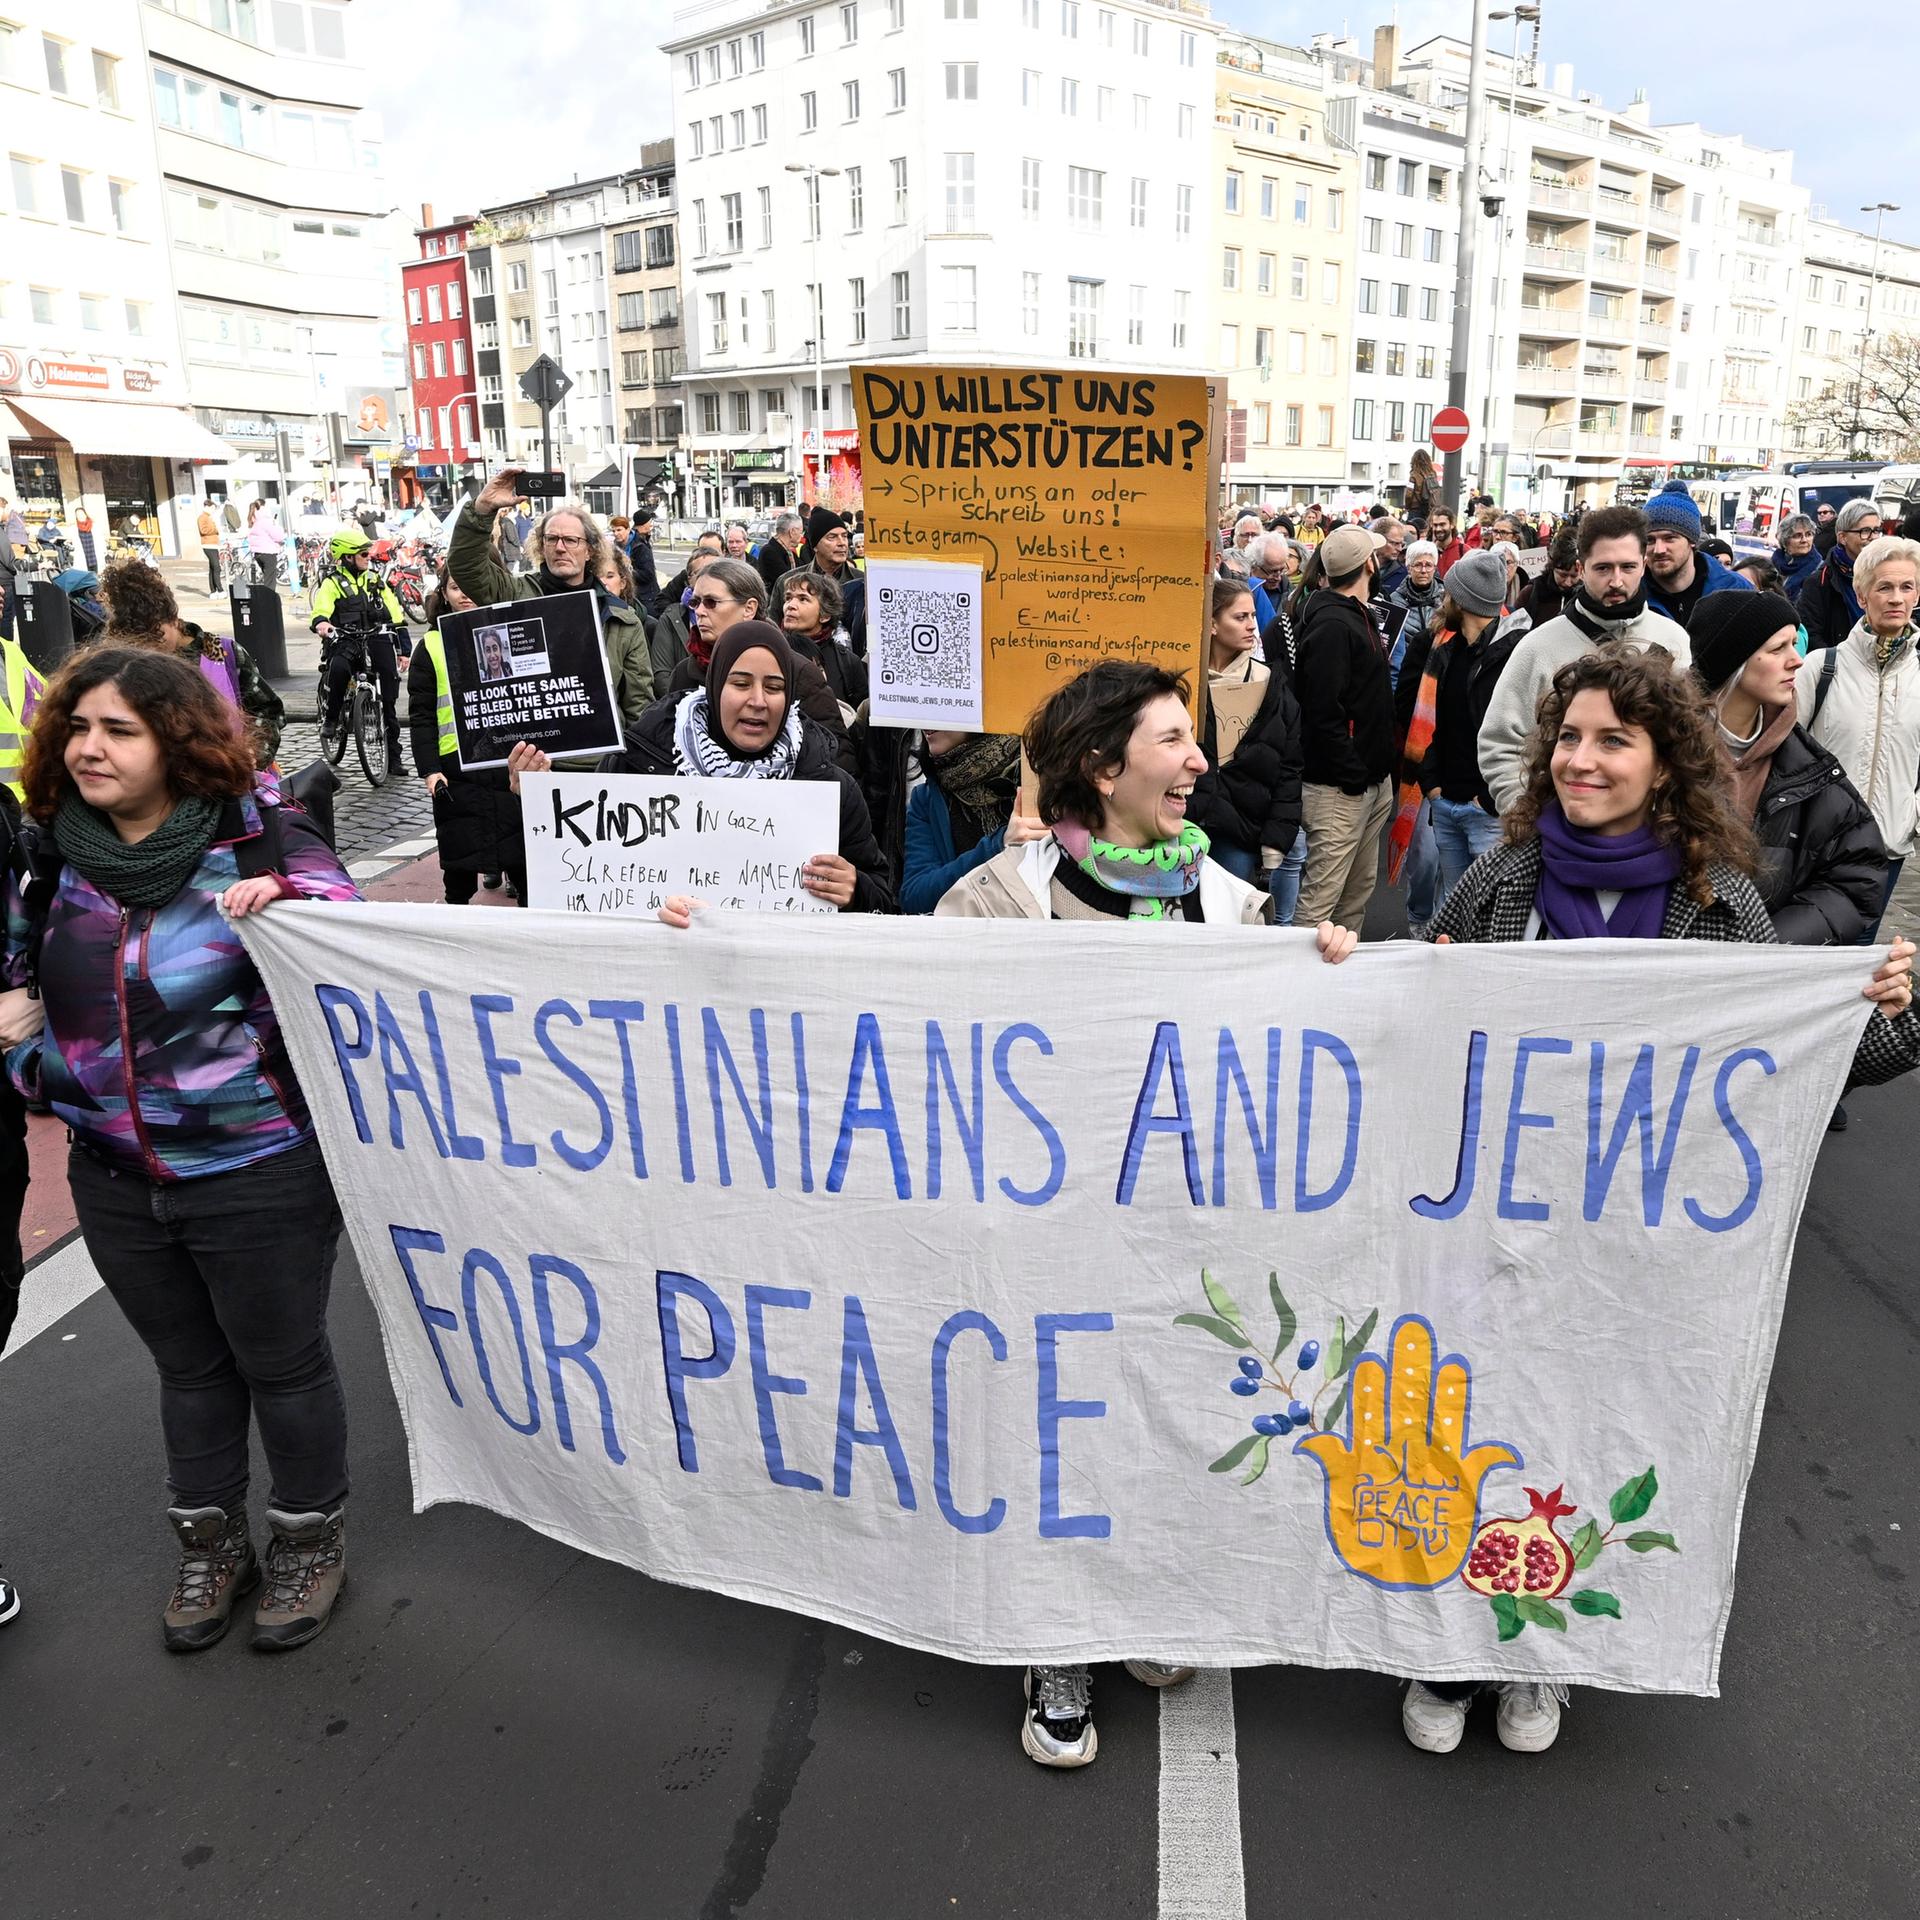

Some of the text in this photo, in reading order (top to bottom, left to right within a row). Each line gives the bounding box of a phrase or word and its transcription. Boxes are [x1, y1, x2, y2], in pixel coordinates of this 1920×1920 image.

[863, 373, 1155, 420] DU WILLST UNS
[869, 418, 1204, 471] UNTERSTÜTZEN?
[900, 475, 1148, 507] Sprich uns an oder
[1063, 504, 1120, 527] uns!
[868, 518, 978, 550] Instagram
[1047, 587, 1146, 604] wordpress.com
[990, 632, 1191, 659] palestiniansandjewsforpeace
[463, 676, 584, 704] WE LOOK THE SAME.
[464, 689, 590, 717] WE BLEED THE SAME.
[465, 703, 595, 731] WE DESERVE BETTER.
[314, 983, 1778, 1233] PALESTINIANS AND JEWS
[388, 1224, 1114, 1539] FOR PEACE
[1359, 1490, 1451, 1526] PEACE
